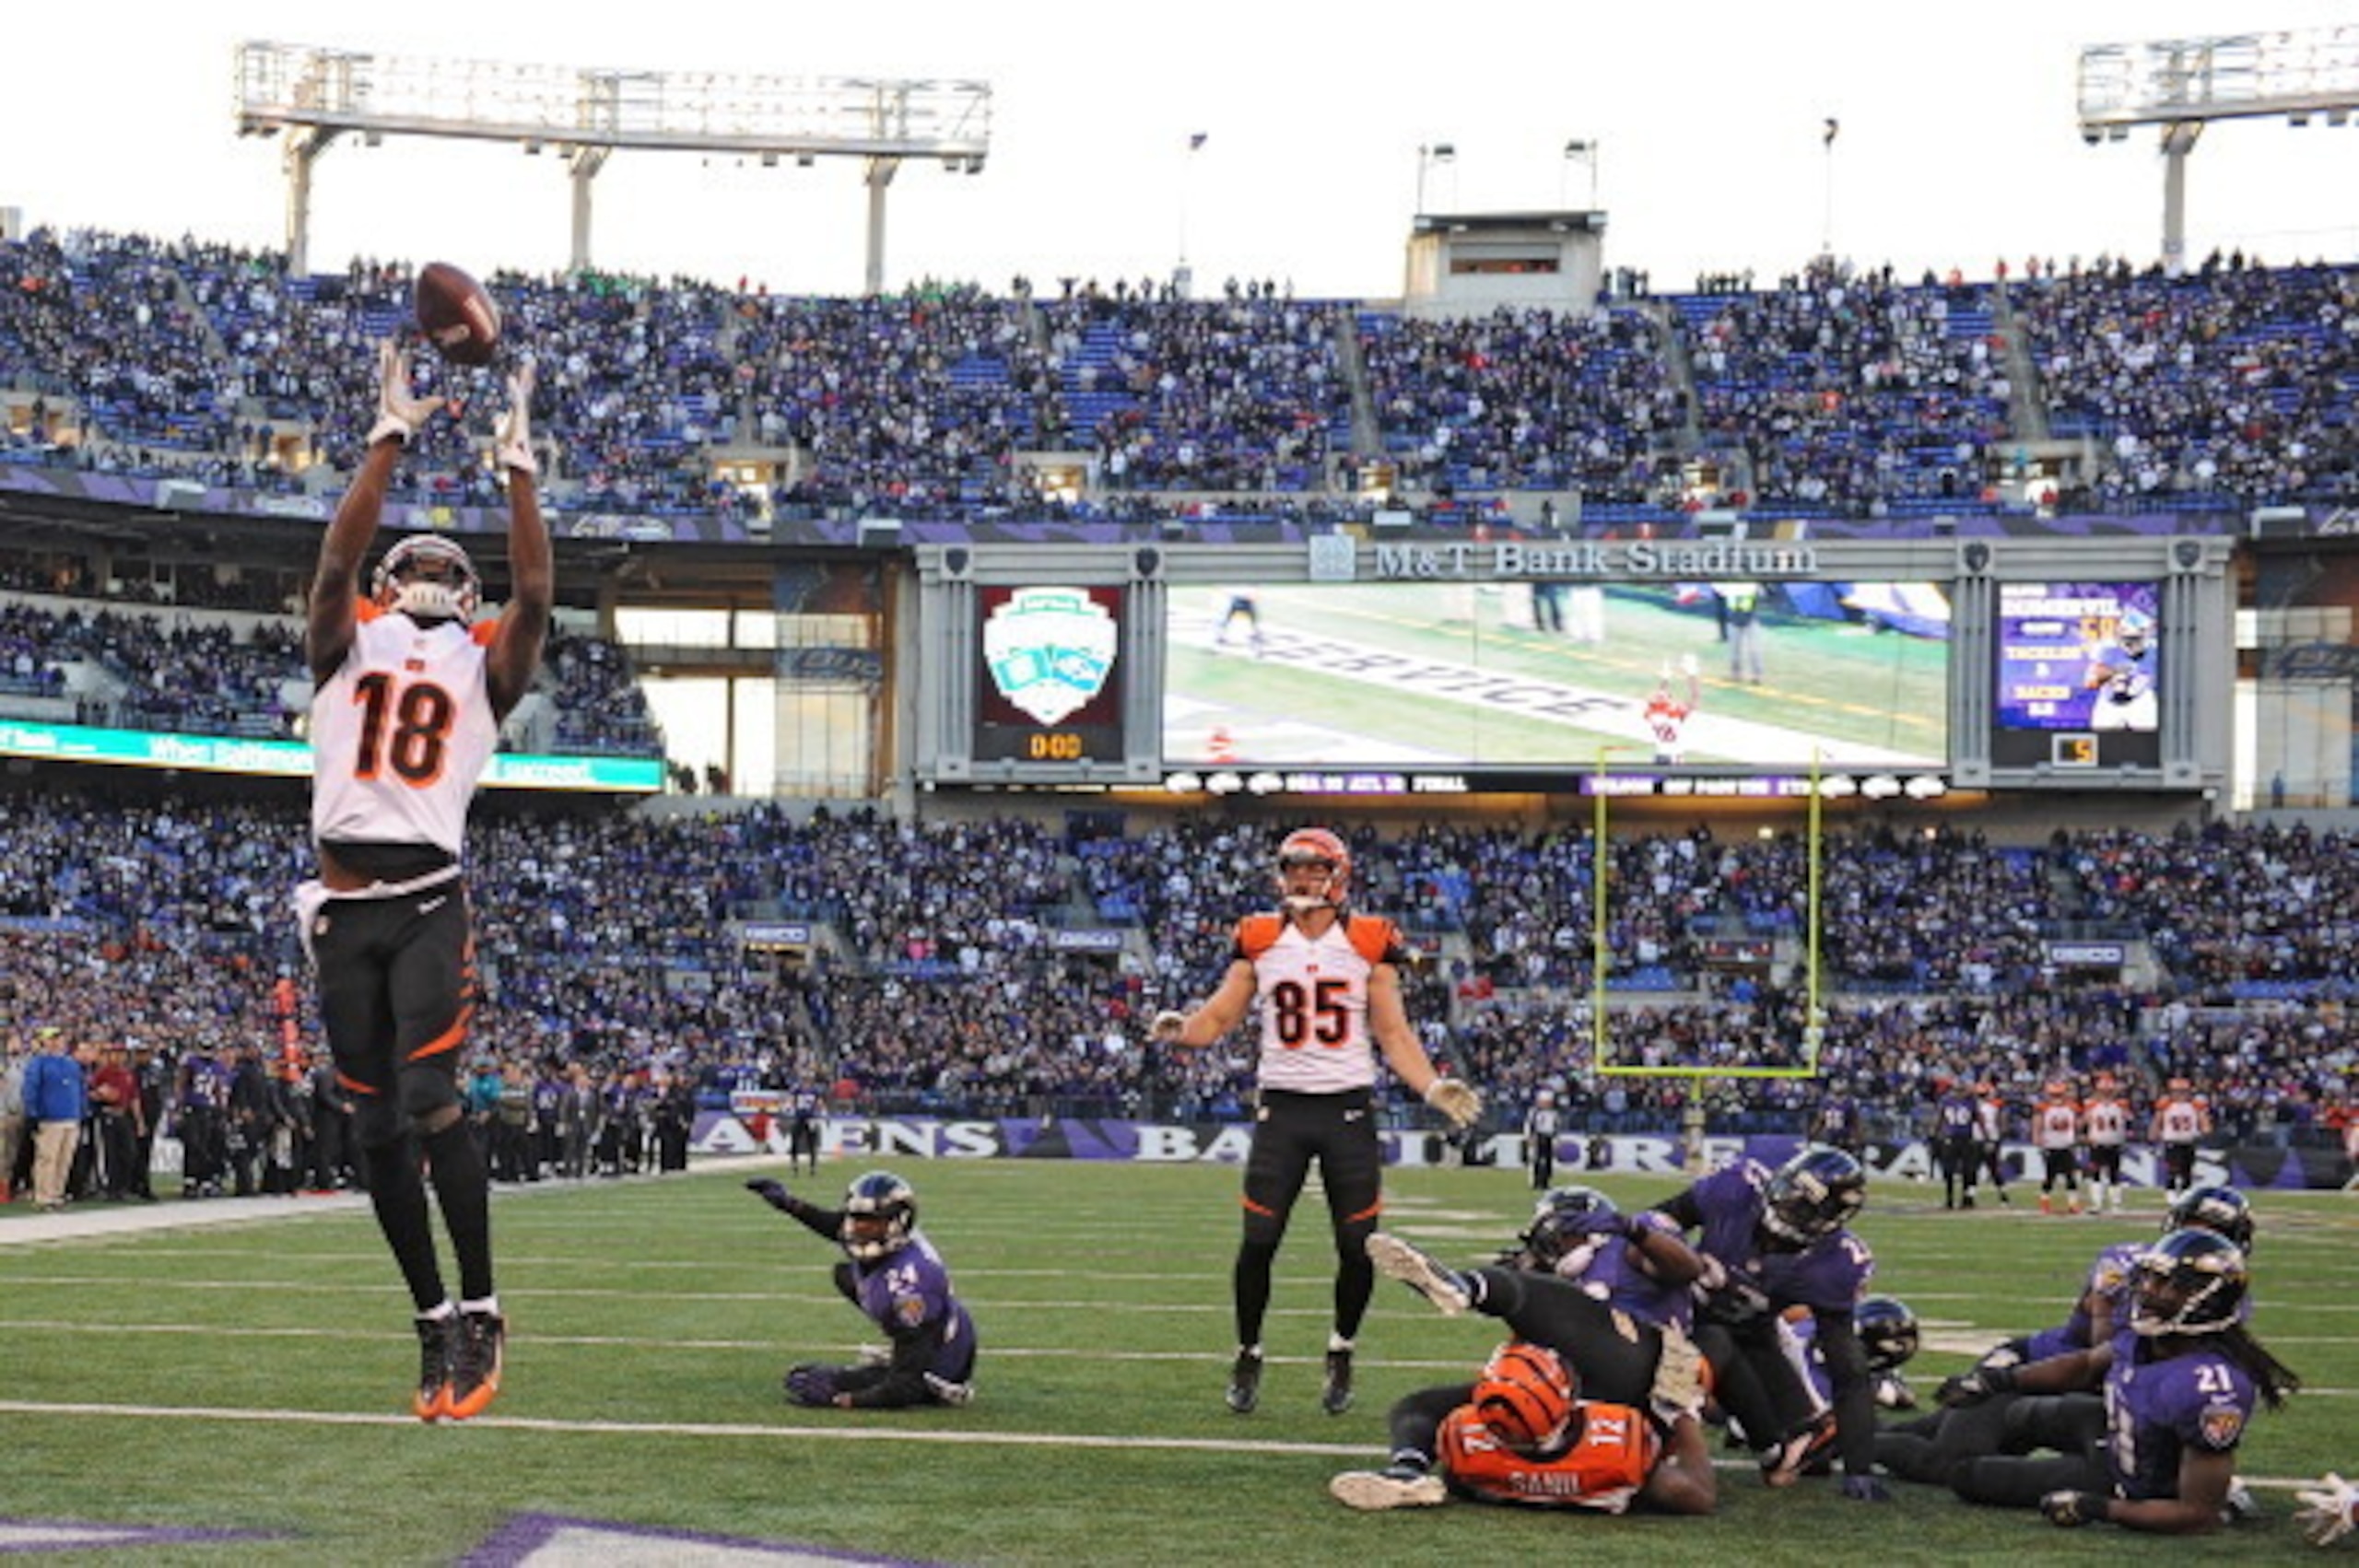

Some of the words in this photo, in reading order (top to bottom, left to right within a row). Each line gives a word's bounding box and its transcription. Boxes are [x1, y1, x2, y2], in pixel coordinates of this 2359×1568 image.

[1376, 543, 1471, 578] M&T
[1494, 542, 1611, 575] Bank
[1625, 542, 1820, 575] Stadium
[352, 671, 458, 790] 18
[1273, 977, 1350, 1048] 85
[2193, 1363, 2234, 1392] 21
